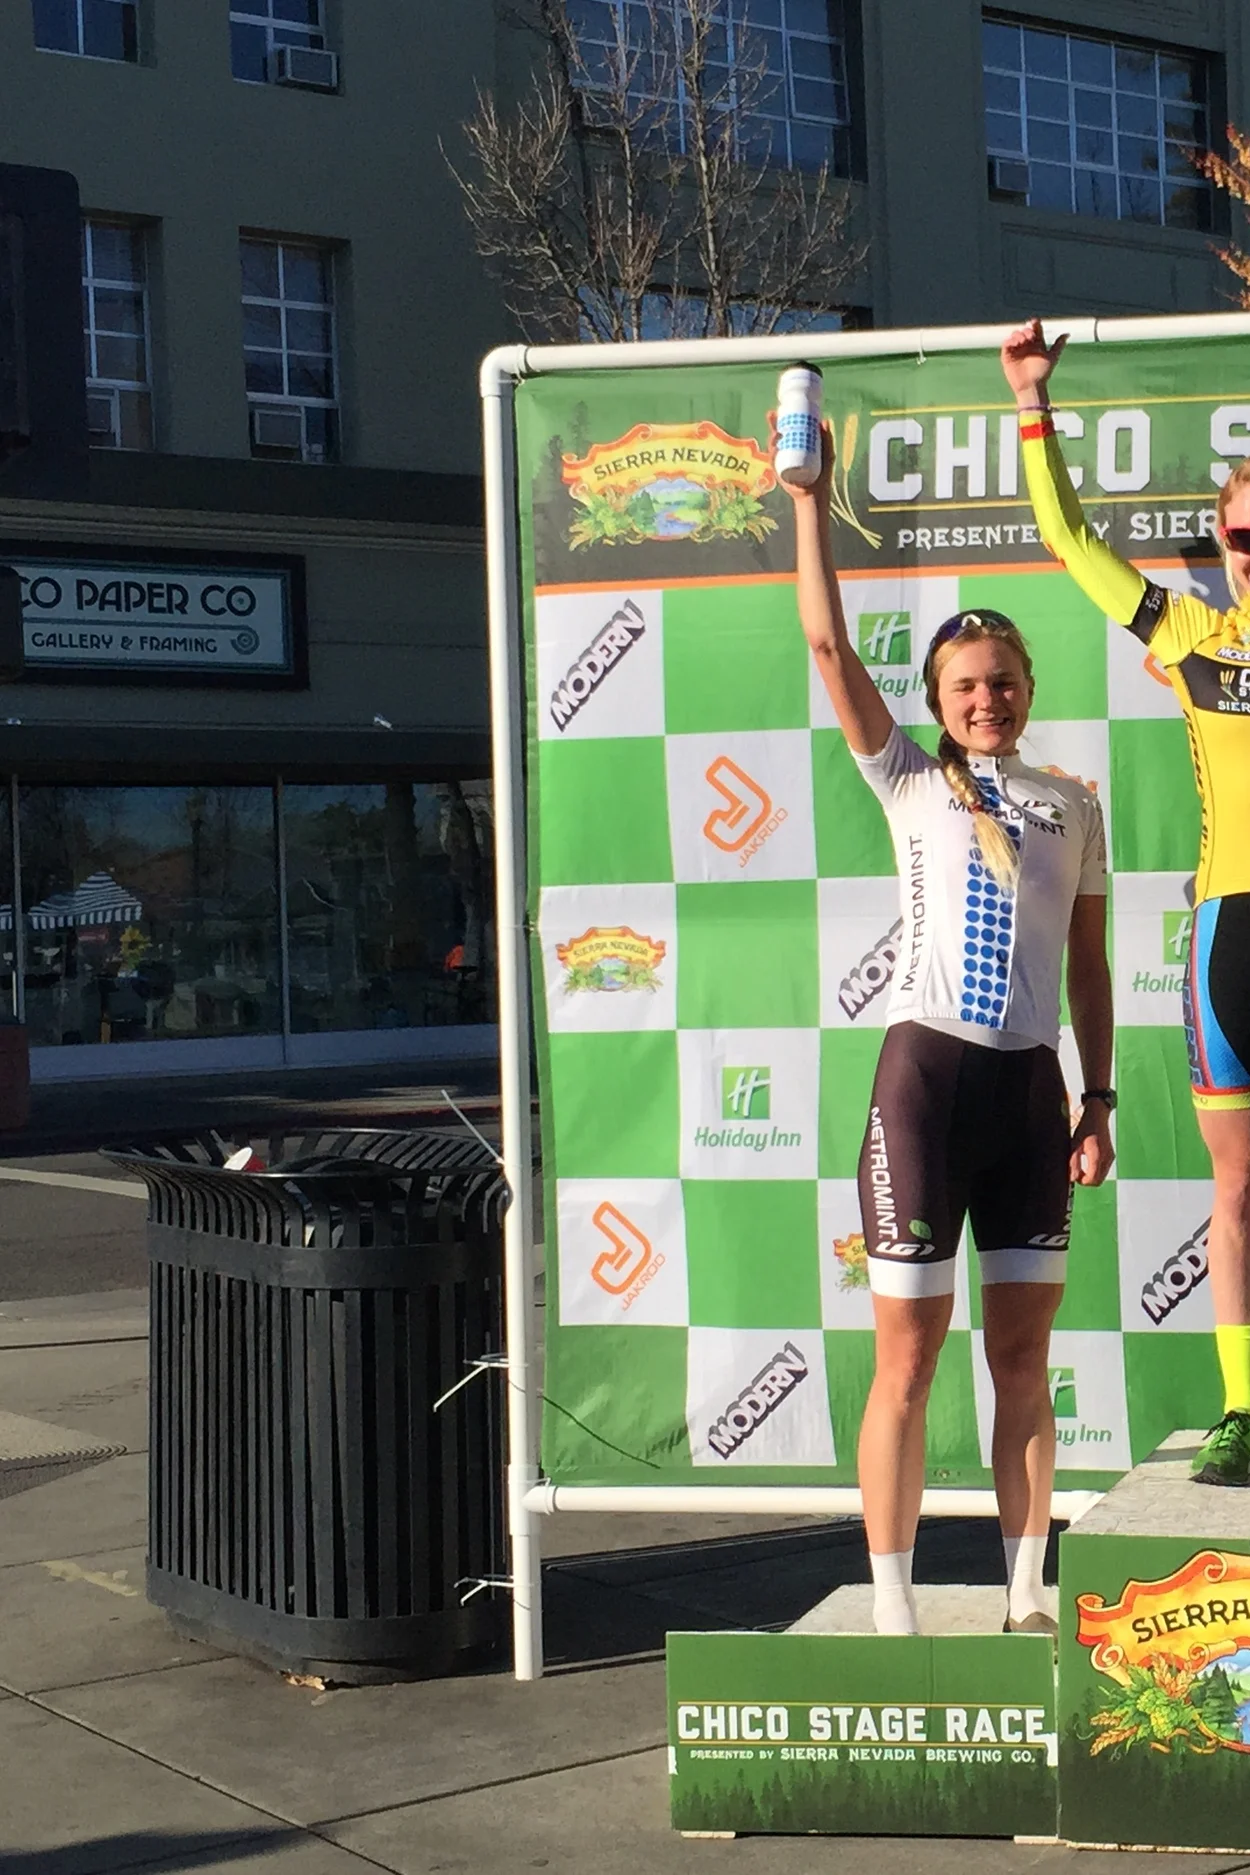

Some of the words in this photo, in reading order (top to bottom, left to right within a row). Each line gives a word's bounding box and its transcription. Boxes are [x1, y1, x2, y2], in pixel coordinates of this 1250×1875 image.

[594, 451, 667, 481] SIERRA
[672, 446, 751, 476] NEVADA
[897, 523, 1045, 552] PRESENTE
[1128, 509, 1219, 541] SIER
[75, 578, 190, 615] PAPER
[200, 583, 257, 617] CO
[31, 632, 114, 650] GALLERY
[120, 636, 133, 650] &
[139, 636, 218, 653] FRAMING
[549, 597, 647, 732] MODERN
[900, 834, 925, 992] METROMINT
[838, 916, 904, 1021] MOD
[1132, 971, 1184, 993] Holi
[694, 1127, 768, 1152] Holiday
[770, 1126, 802, 1147] Inn
[1141, 1215, 1213, 1326] MOD
[708, 1341, 809, 1460] MODERN
[1079, 1423, 1113, 1442] Inn
[677, 1705, 789, 1741] CHICO
[809, 1707, 927, 1742] STAGE
[946, 1708, 1045, 1744] RACE
[689, 1750, 754, 1760] PRESENTED
[759, 1751, 774, 1760] BY
[780, 1747, 839, 1762] SIERRA
[849, 1747, 916, 1763] NEVADA
[926, 1748, 1003, 1764] BREWING
[1011, 1751, 1036, 1764] CO.
